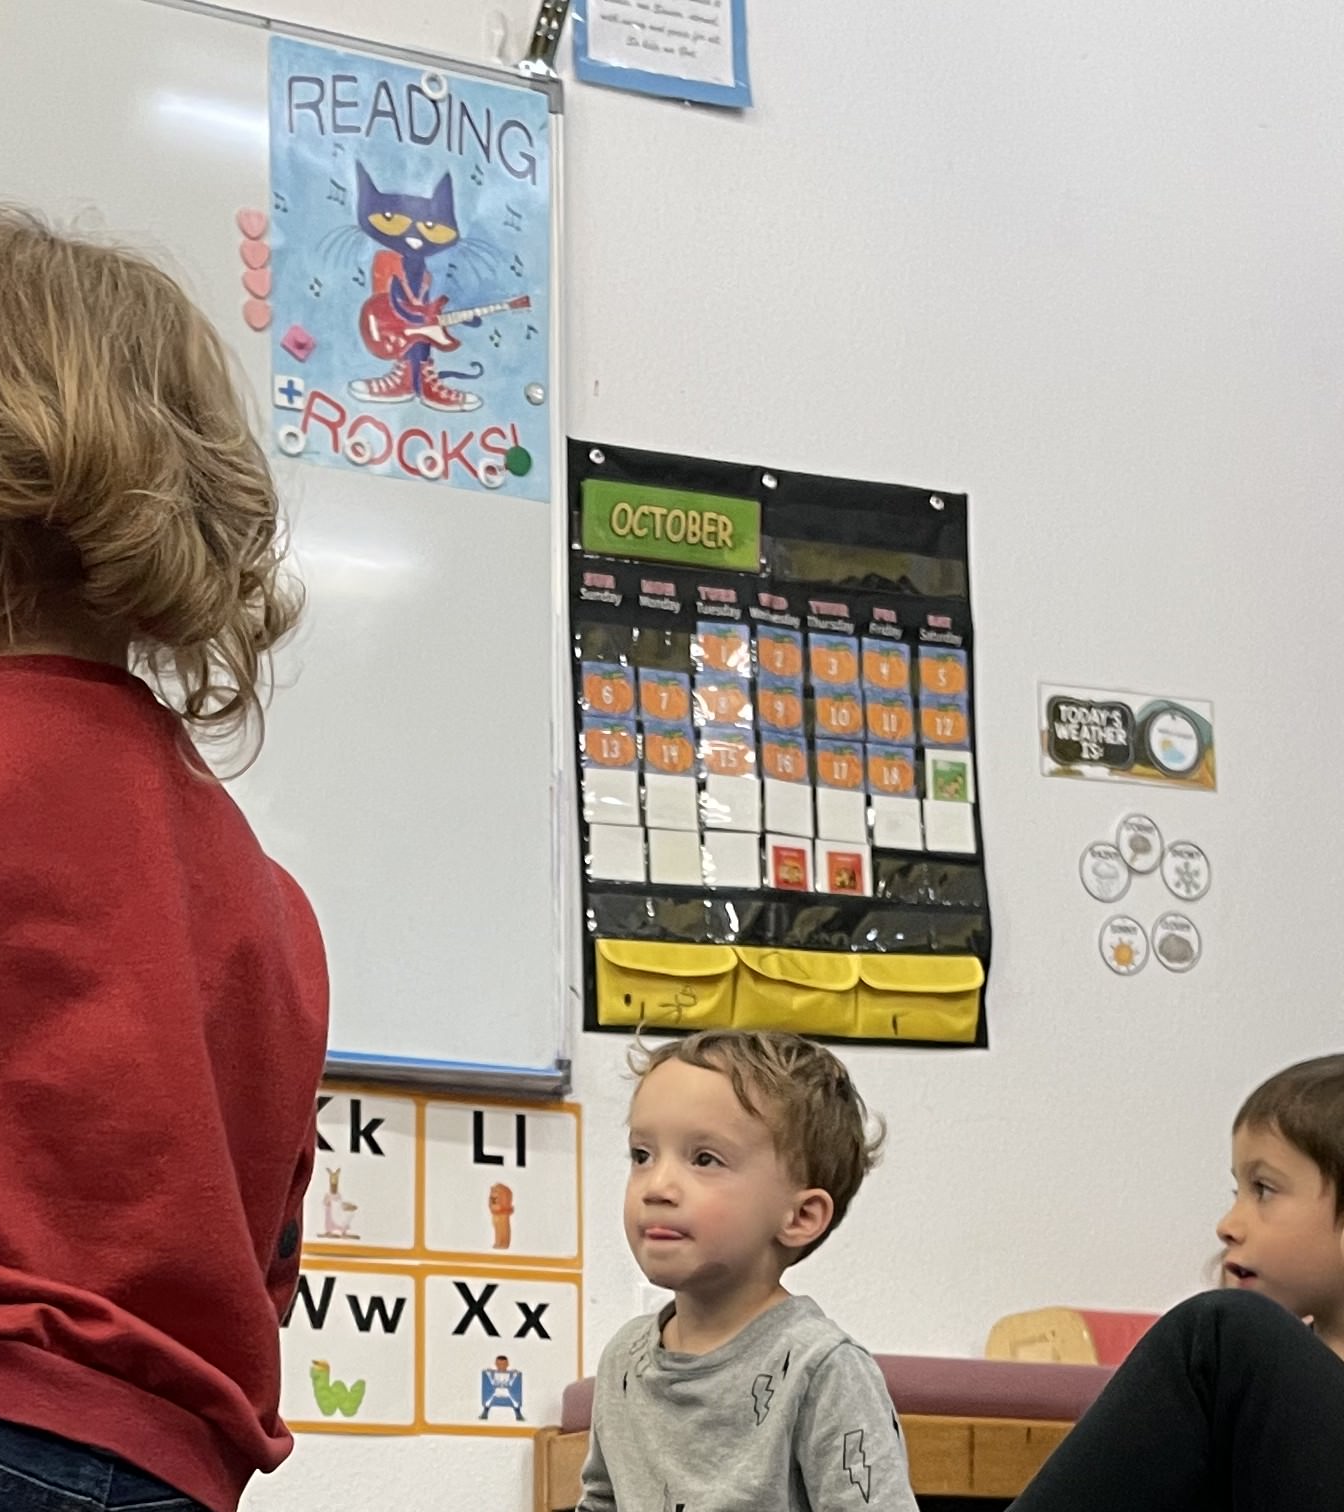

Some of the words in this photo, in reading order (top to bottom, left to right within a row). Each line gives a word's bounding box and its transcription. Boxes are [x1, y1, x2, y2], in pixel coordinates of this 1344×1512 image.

[288, 75, 537, 186] READING
[611, 502, 734, 548] OCTOBER
[828, 658, 838, 675] 3
[601, 685, 613, 705] 6
[830, 706, 850, 727] 10
[882, 712, 897, 733] 11
[935, 717, 953, 737] 12
[1054, 722, 1128, 746] WEATHER
[1058, 704, 1122, 728] TODAY'S
[601, 738, 621, 758] 13
[662, 744, 679, 764] 14
[719, 749, 736, 768] 15
[833, 761, 848, 780] 17
[472, 1110, 527, 1168] Ll
[452, 1281, 552, 1341] Xx
